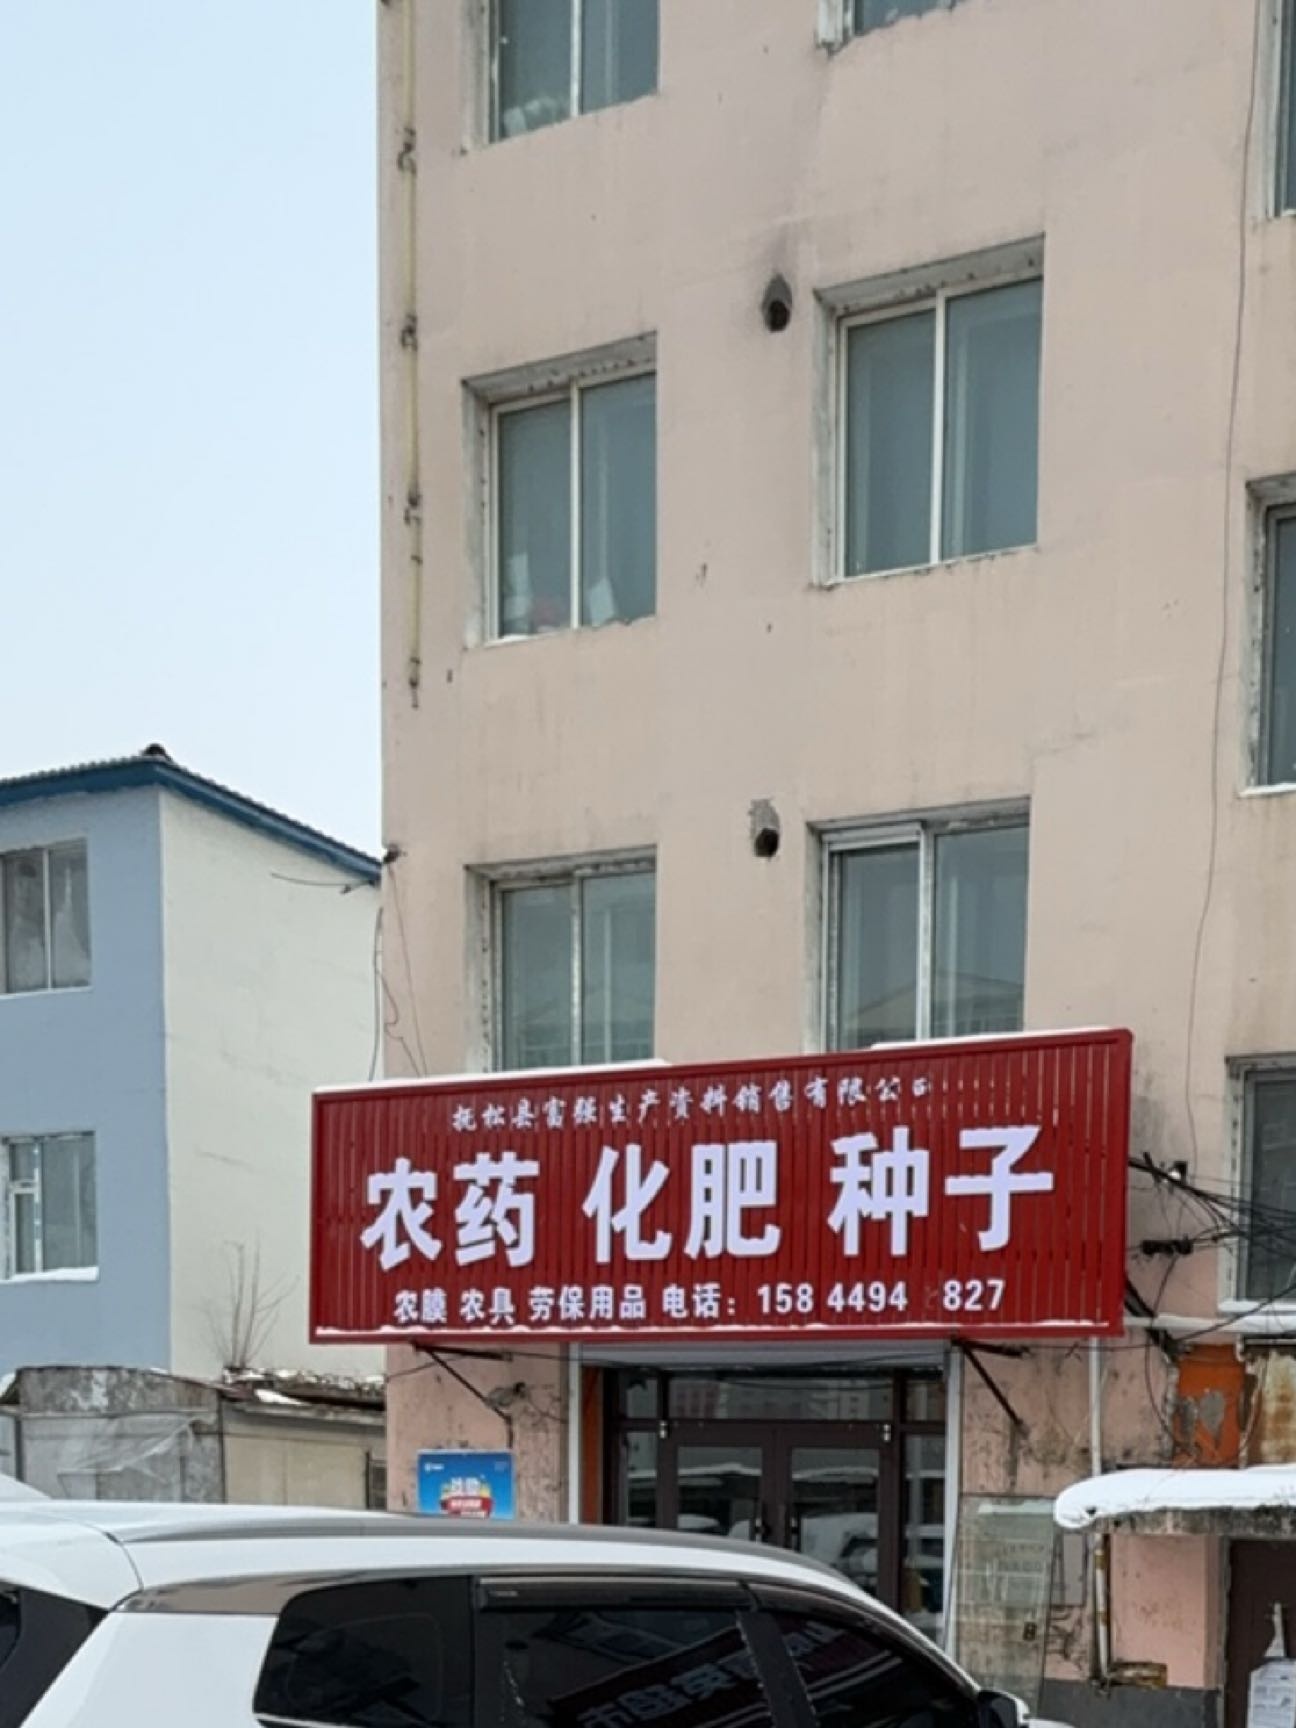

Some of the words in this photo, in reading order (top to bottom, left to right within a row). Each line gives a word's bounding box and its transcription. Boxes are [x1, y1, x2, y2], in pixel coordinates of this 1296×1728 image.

[360, 1152, 540, 1271] 农药
[583, 1140, 781, 1262] 化肥
[827, 1122, 1056, 1256] 种子
[394, 1287, 448, 1325] 农膜
[459, 1286, 516, 1326] 农具
[528, 1283, 647, 1322] 劳保用品
[757, 1282, 814, 1314] 158
[827, 1281, 909, 1313] 4494
